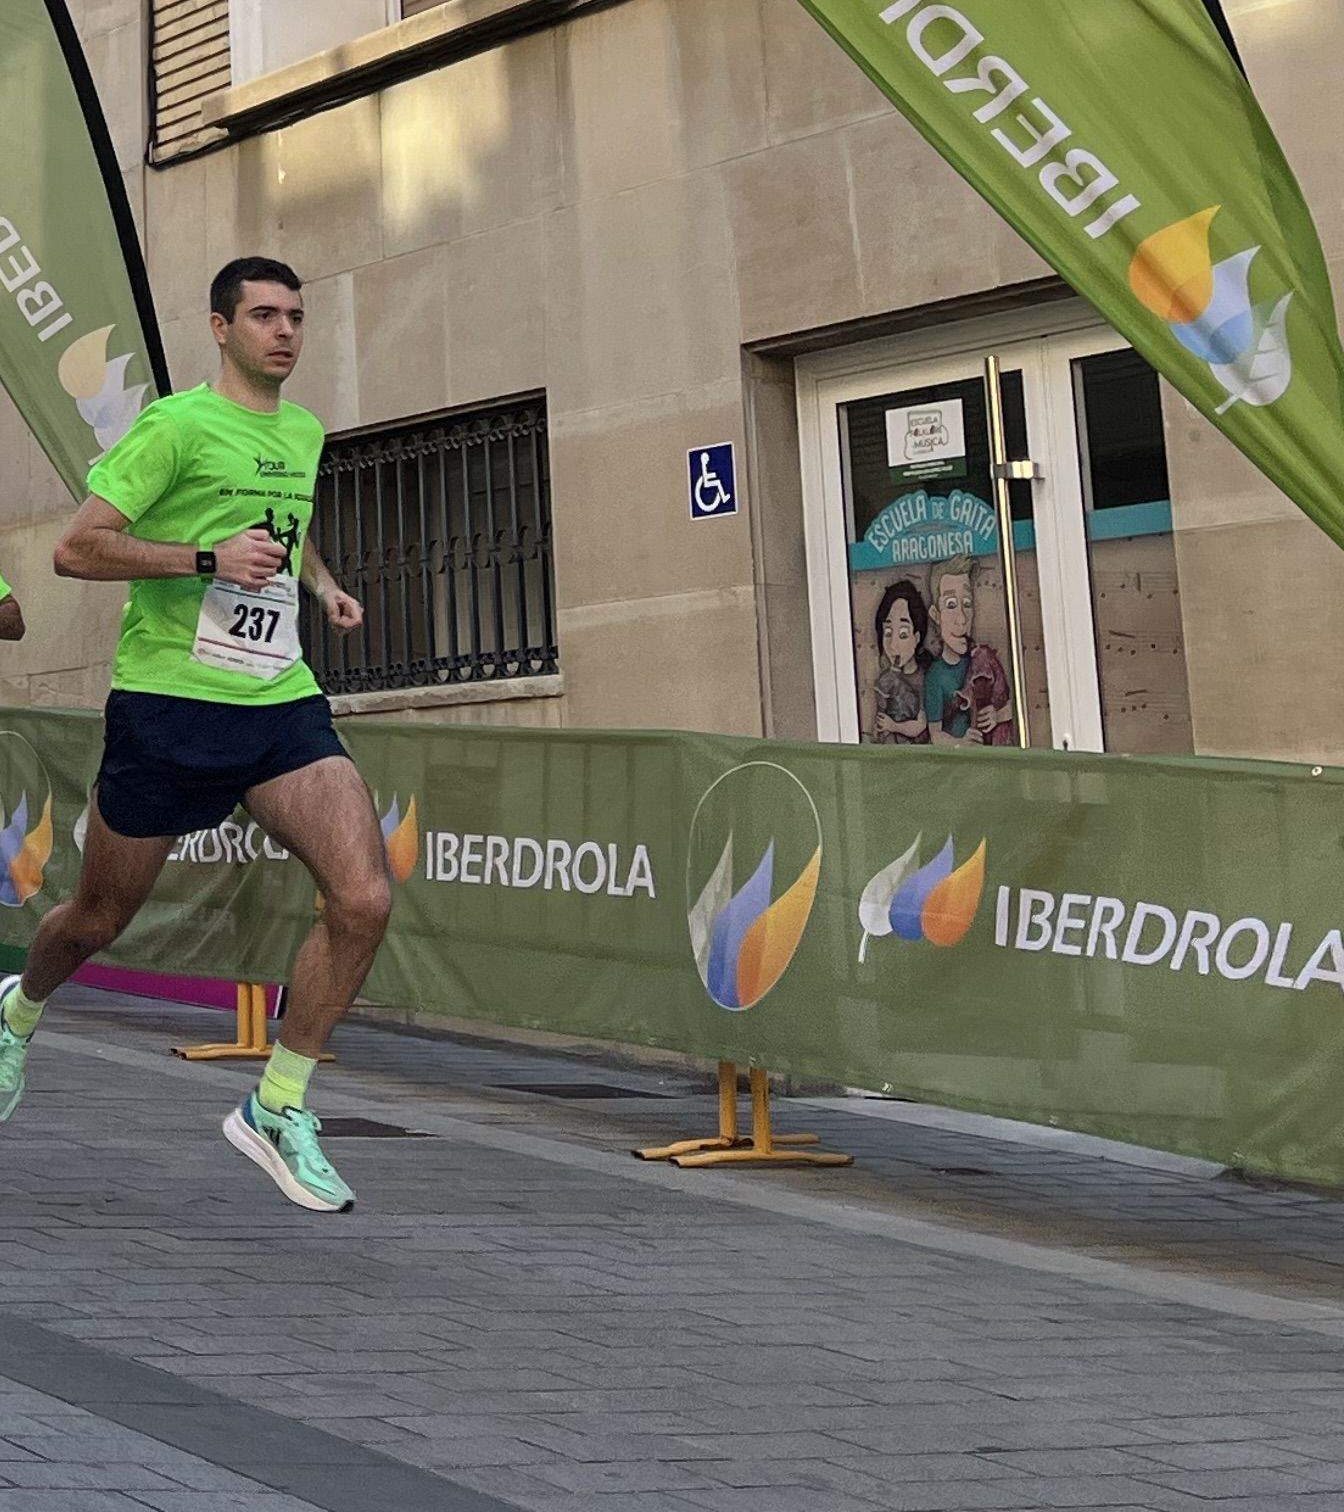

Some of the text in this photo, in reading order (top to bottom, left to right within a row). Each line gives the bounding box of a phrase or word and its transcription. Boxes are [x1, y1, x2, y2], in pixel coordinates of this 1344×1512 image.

[867, 494, 997, 554] ESCUELA DE GAITA
[891, 530, 974, 563] ARAGONESA
[228, 603, 281, 644] 237
[425, 830, 657, 899] IBERDROLA
[994, 884, 1344, 993] IBERDROLA
